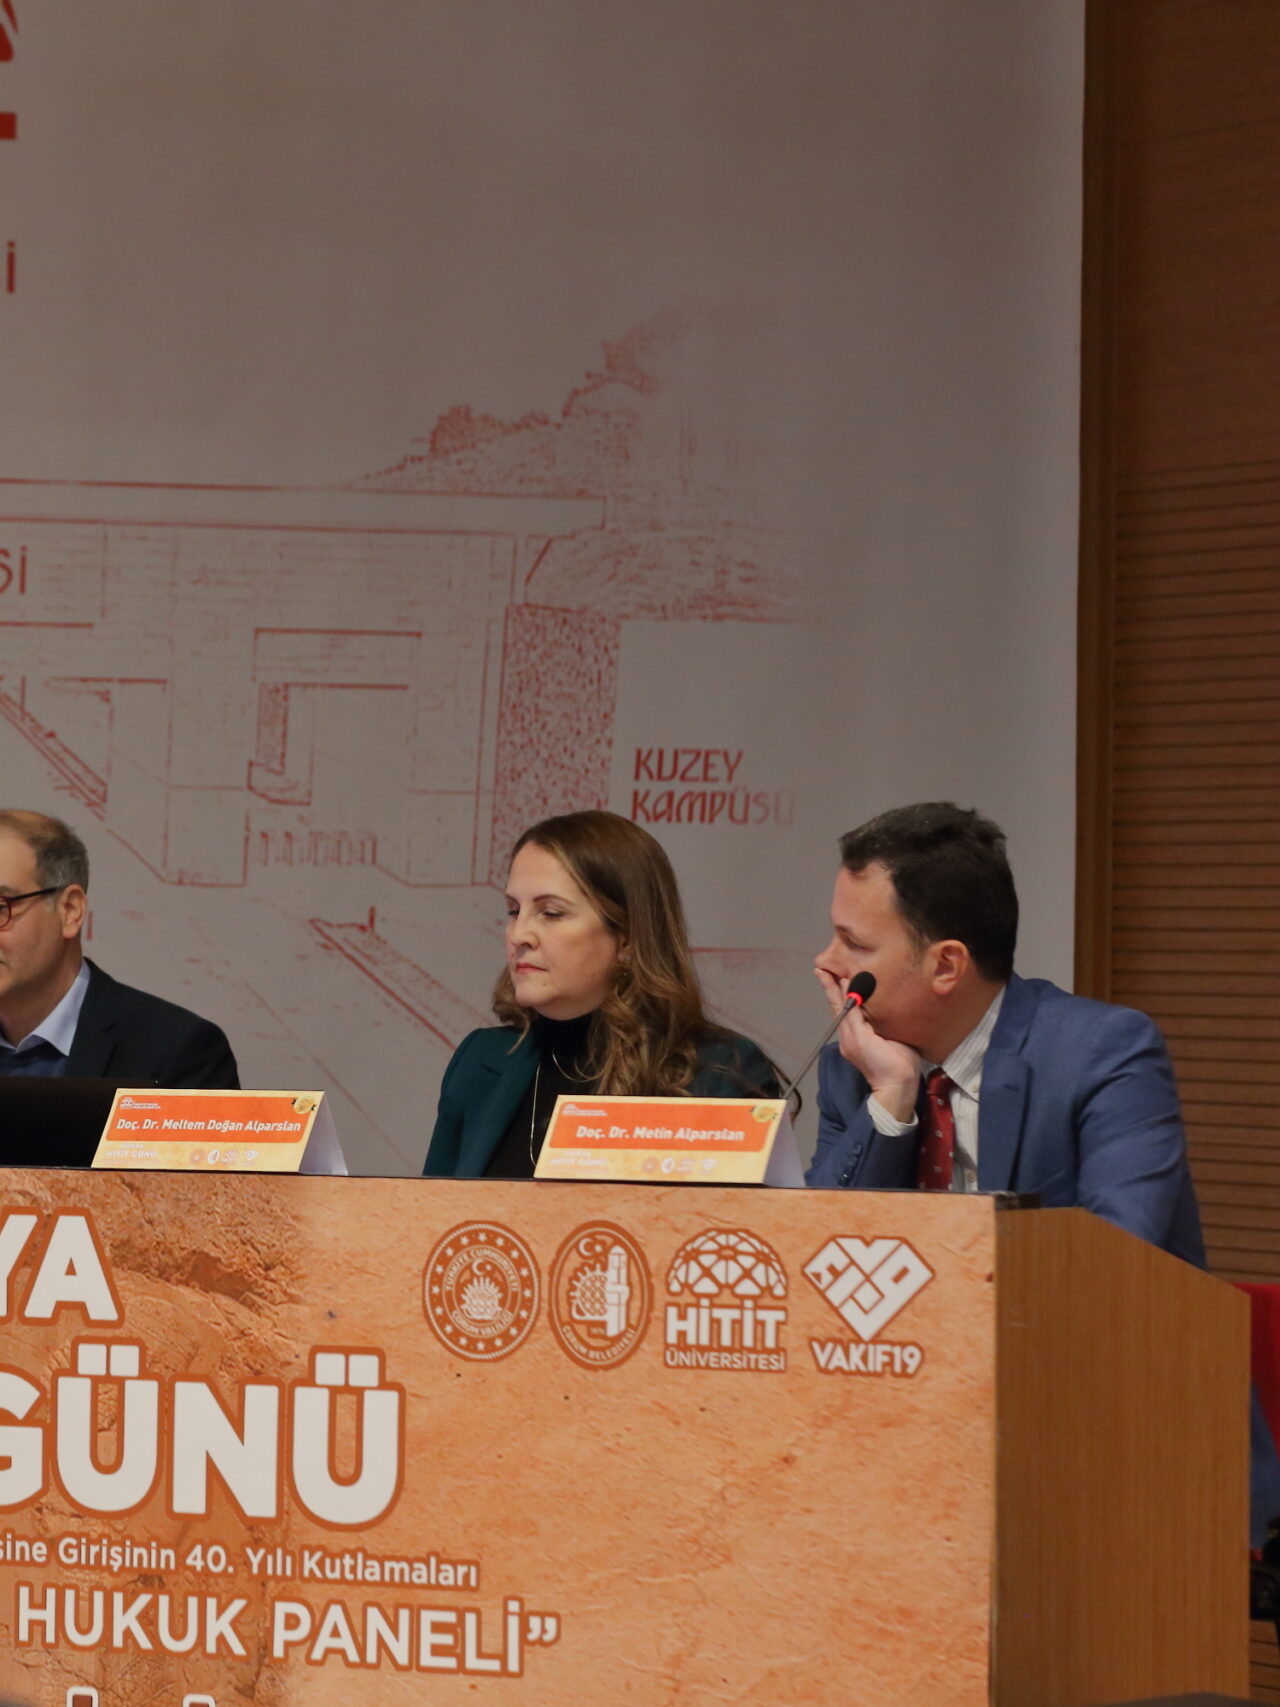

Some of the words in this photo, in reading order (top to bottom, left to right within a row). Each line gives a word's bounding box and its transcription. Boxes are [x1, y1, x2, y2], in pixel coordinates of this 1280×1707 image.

[633, 747, 743, 783] KUZEY
[116, 1118, 139, 1131] Doç.
[142, 1119, 160, 1130] Dr.
[162, 1119, 204, 1131] Meltem
[207, 1120, 243, 1133] Doğan
[244, 1120, 301, 1134] Alparslan
[576, 1125, 604, 1139] Doç.
[608, 1126, 630, 1138] Dr.
[632, 1126, 672, 1139] Metin
[674, 1127, 744, 1142] Alparslan
[666, 1298, 787, 1348] HİTİT
[666, 1349, 786, 1371] ÜNİVERSİTESİ
[811, 1341, 922, 1375] VAKIF19
[58, 1537, 175, 1573] Girişinin
[185, 1546, 235, 1575] 40.
[245, 1548, 293, 1578] Yılı
[302, 1551, 478, 1588] Kutlamaları
[18, 1585, 248, 1657] HUKUK
